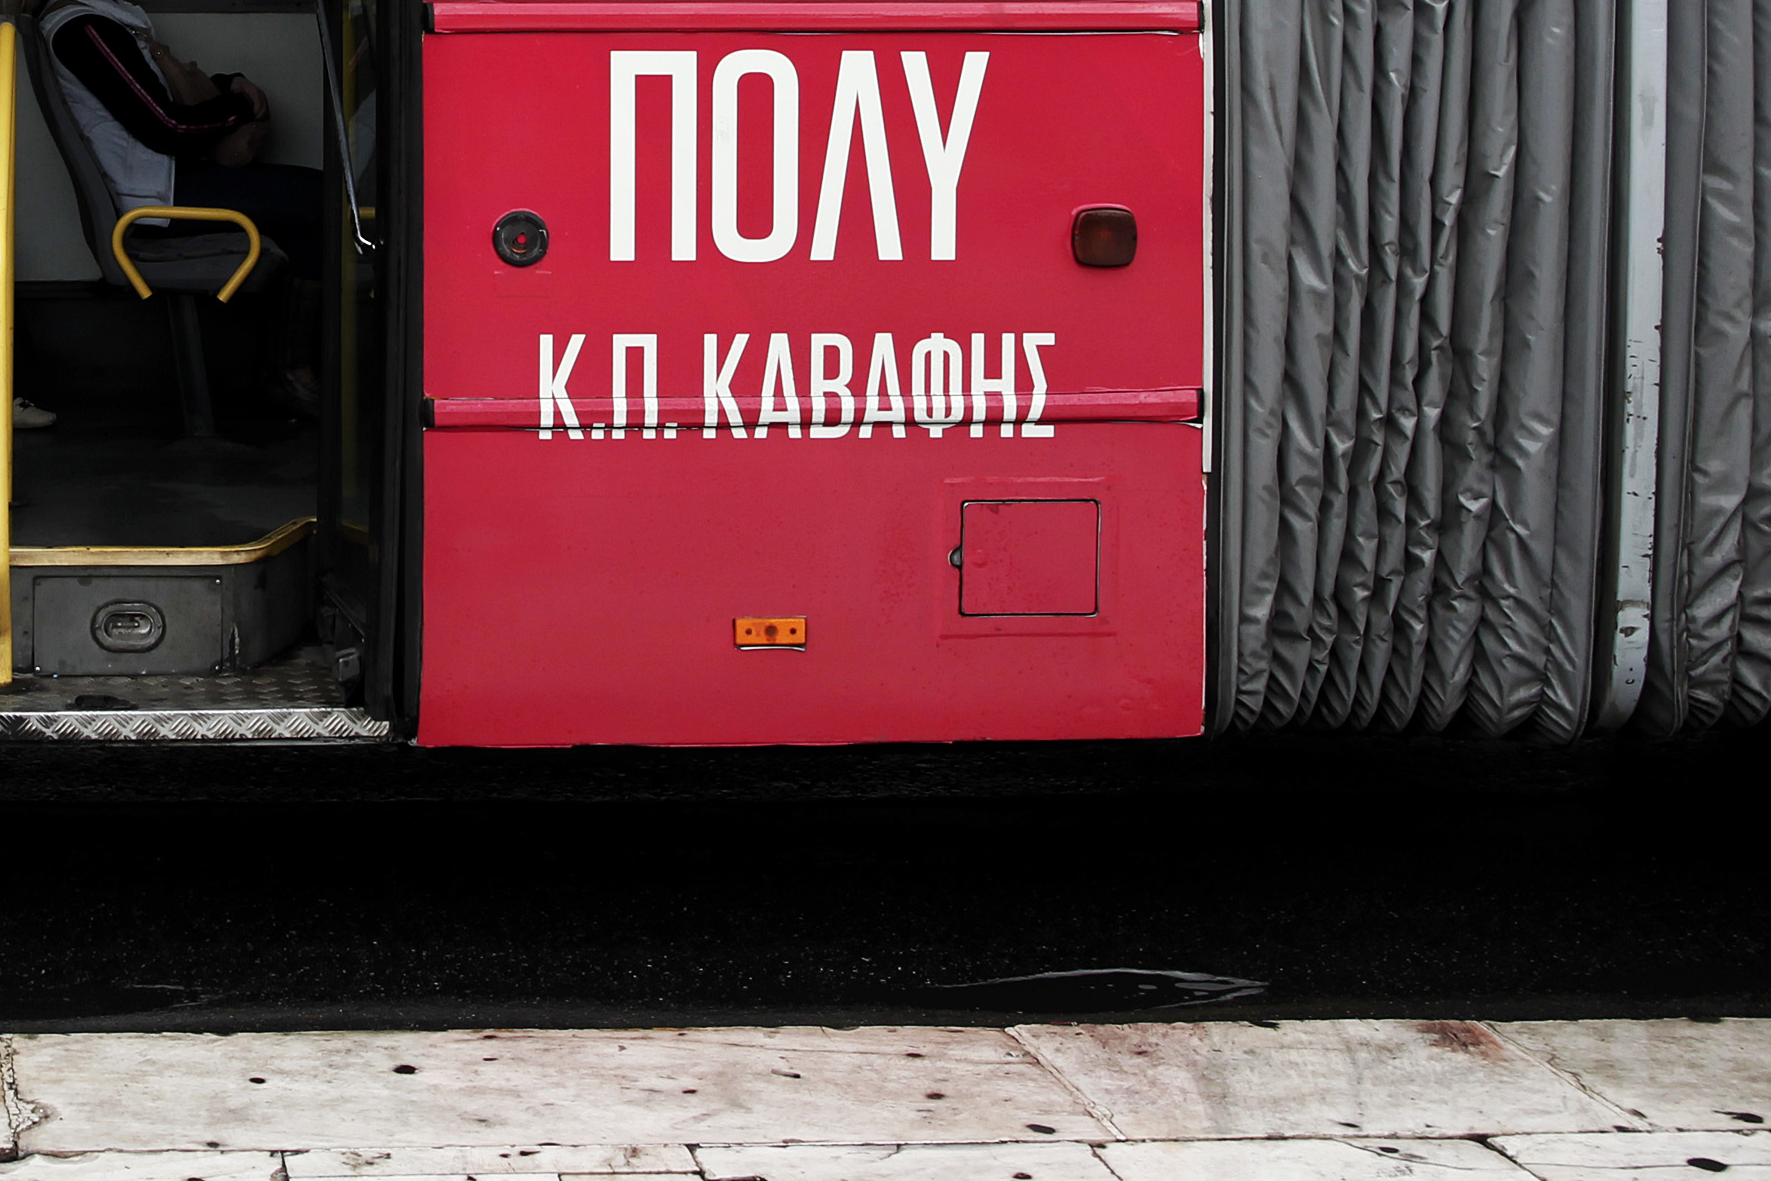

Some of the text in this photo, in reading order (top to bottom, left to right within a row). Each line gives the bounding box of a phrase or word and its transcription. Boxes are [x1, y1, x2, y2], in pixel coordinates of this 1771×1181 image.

[609, 49, 991, 263] ΠΟΛΥ
[538, 332, 1056, 440] Κ.Π. ΚΑΒΑΦΗΣ
